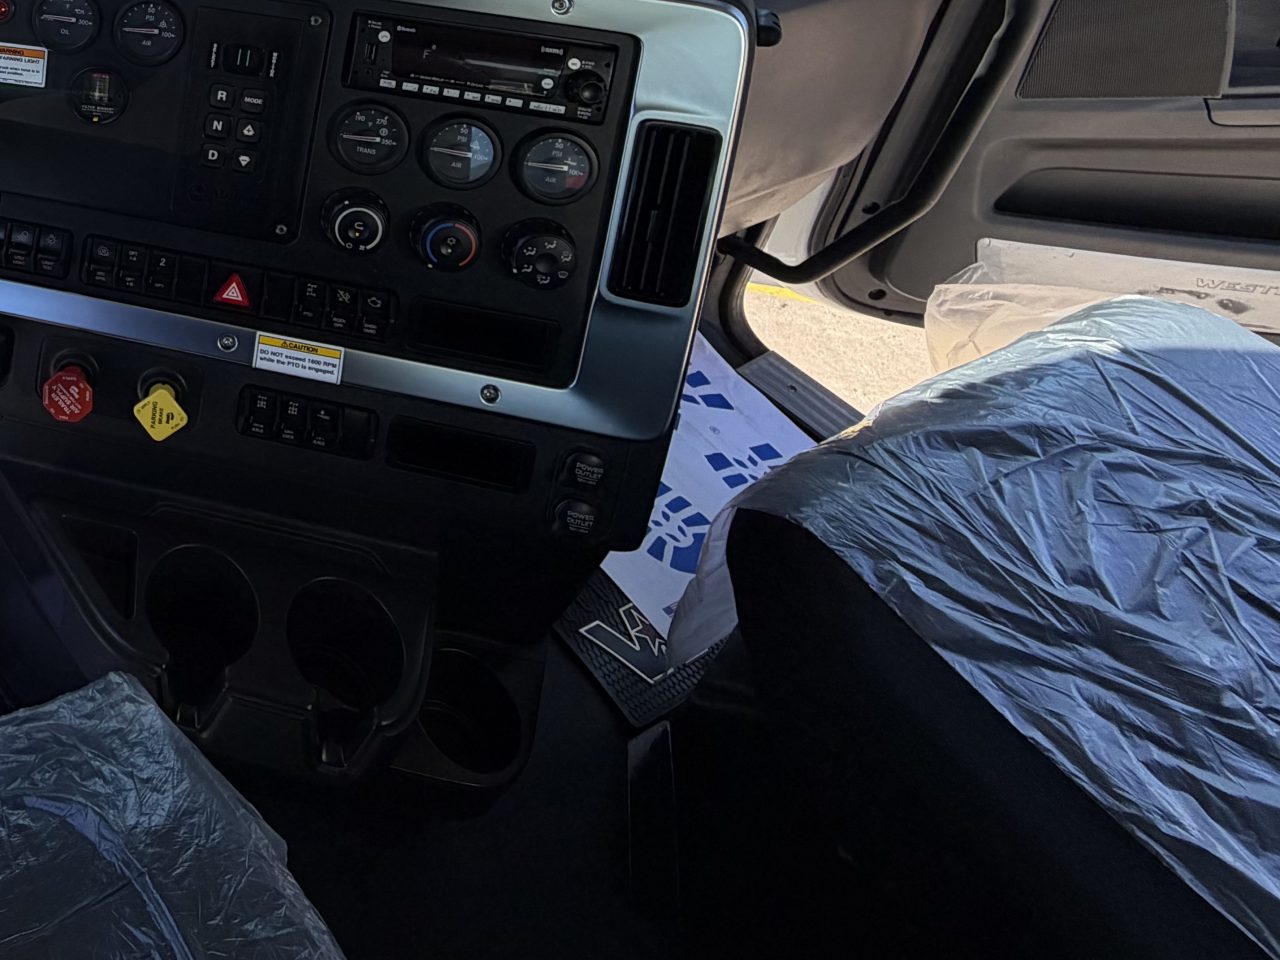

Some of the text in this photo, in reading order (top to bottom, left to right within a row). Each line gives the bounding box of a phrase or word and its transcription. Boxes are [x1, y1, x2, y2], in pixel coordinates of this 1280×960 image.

[148, 6, 156, 14] 50
[141, 39, 152, 47] AIR
[217, 90, 227, 102] R
[244, 96, 264, 105] MODE
[354, 114, 366, 122] 190
[375, 117, 388, 126] 270
[212, 120, 223, 131] N
[460, 127, 468, 135] 50
[356, 146, 376, 156] TRANS
[554, 141, 564, 150] 50
[208, 149, 219, 161] D
[552, 150, 563, 158] PSI
[451, 161, 462, 169] AIR
[159, 257, 167, 267] 2
[1196, 277, 1280, 297] WEST
[288, 342, 319, 353] CAUTION
[260, 356, 275, 364] while
[276, 358, 286, 366] the
[287, 360, 300, 369] PTO
[308, 366, 335, 376] engaged.
[285, 354, 306, 362] exceed
[322, 361, 337, 369] RPM
[150, 401, 158, 429] PARKING
[576, 462, 604, 474] POWER
[576, 468, 602, 479] OUTLET
[567, 510, 595, 521] POWER
[567, 517, 593, 528] OUTLET
